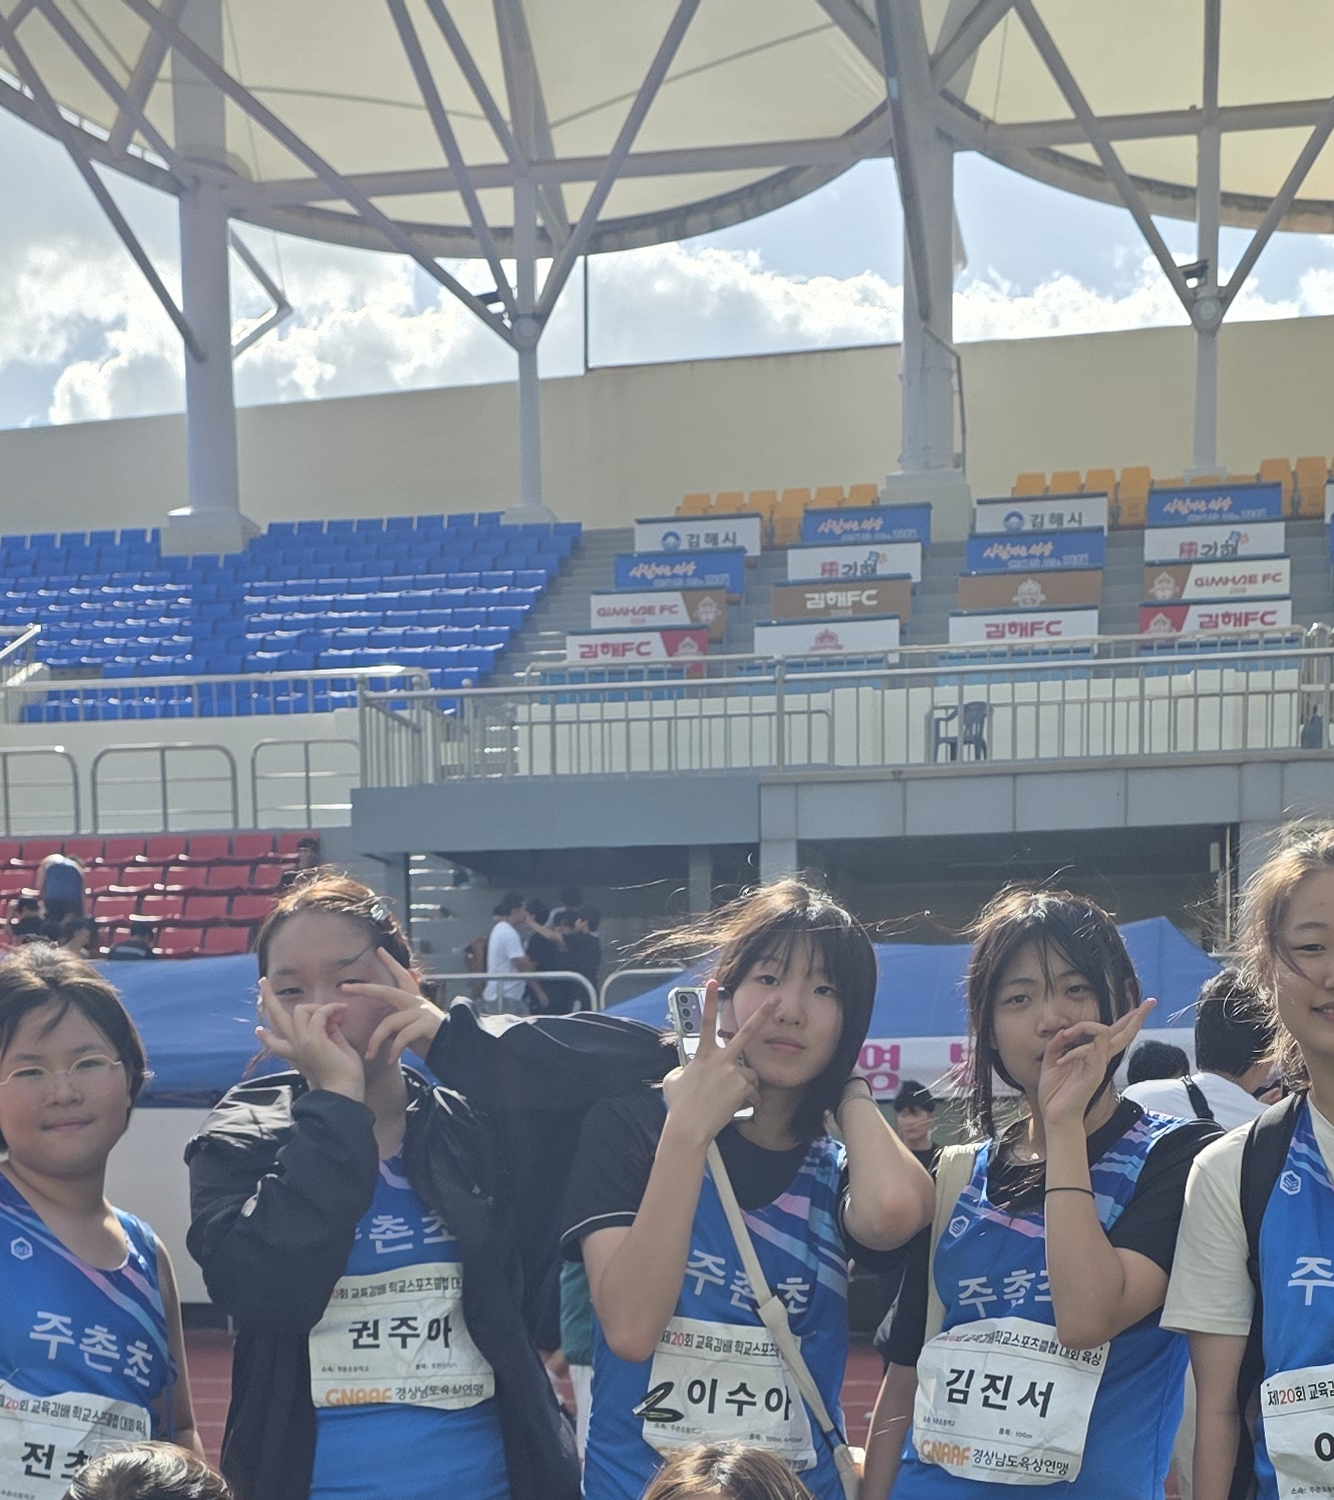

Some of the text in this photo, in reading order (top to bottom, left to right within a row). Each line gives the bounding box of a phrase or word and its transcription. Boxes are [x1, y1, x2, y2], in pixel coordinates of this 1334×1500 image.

[1030, 512, 1083, 528] 김해시
[686, 531, 737, 548] 김해시
[804, 589, 878, 610] 김해FC
[984, 620, 1062, 639] 김해FC
[1198, 610, 1277, 629] 김해FC
[578, 641, 652, 659] 김해FC
[355, 1209, 457, 1254] 촌초
[348, 1315, 452, 1349] 권주아
[30, 1311, 153, 1387] 주촌초
[995, 1330, 1059, 1355] 학교스포츠클럽
[1081, 1351, 1102, 1366] 육상
[325, 1386, 392, 1406] GNAAF
[687, 1379, 792, 1421] 이수아
[946, 1368, 1055, 1418] 김진서
[1268, 1385, 1306, 1406] 제20회
[921, 1440, 971, 1466] GNAAF
[972, 1449, 1069, 1476] 경상남도육상연맹
